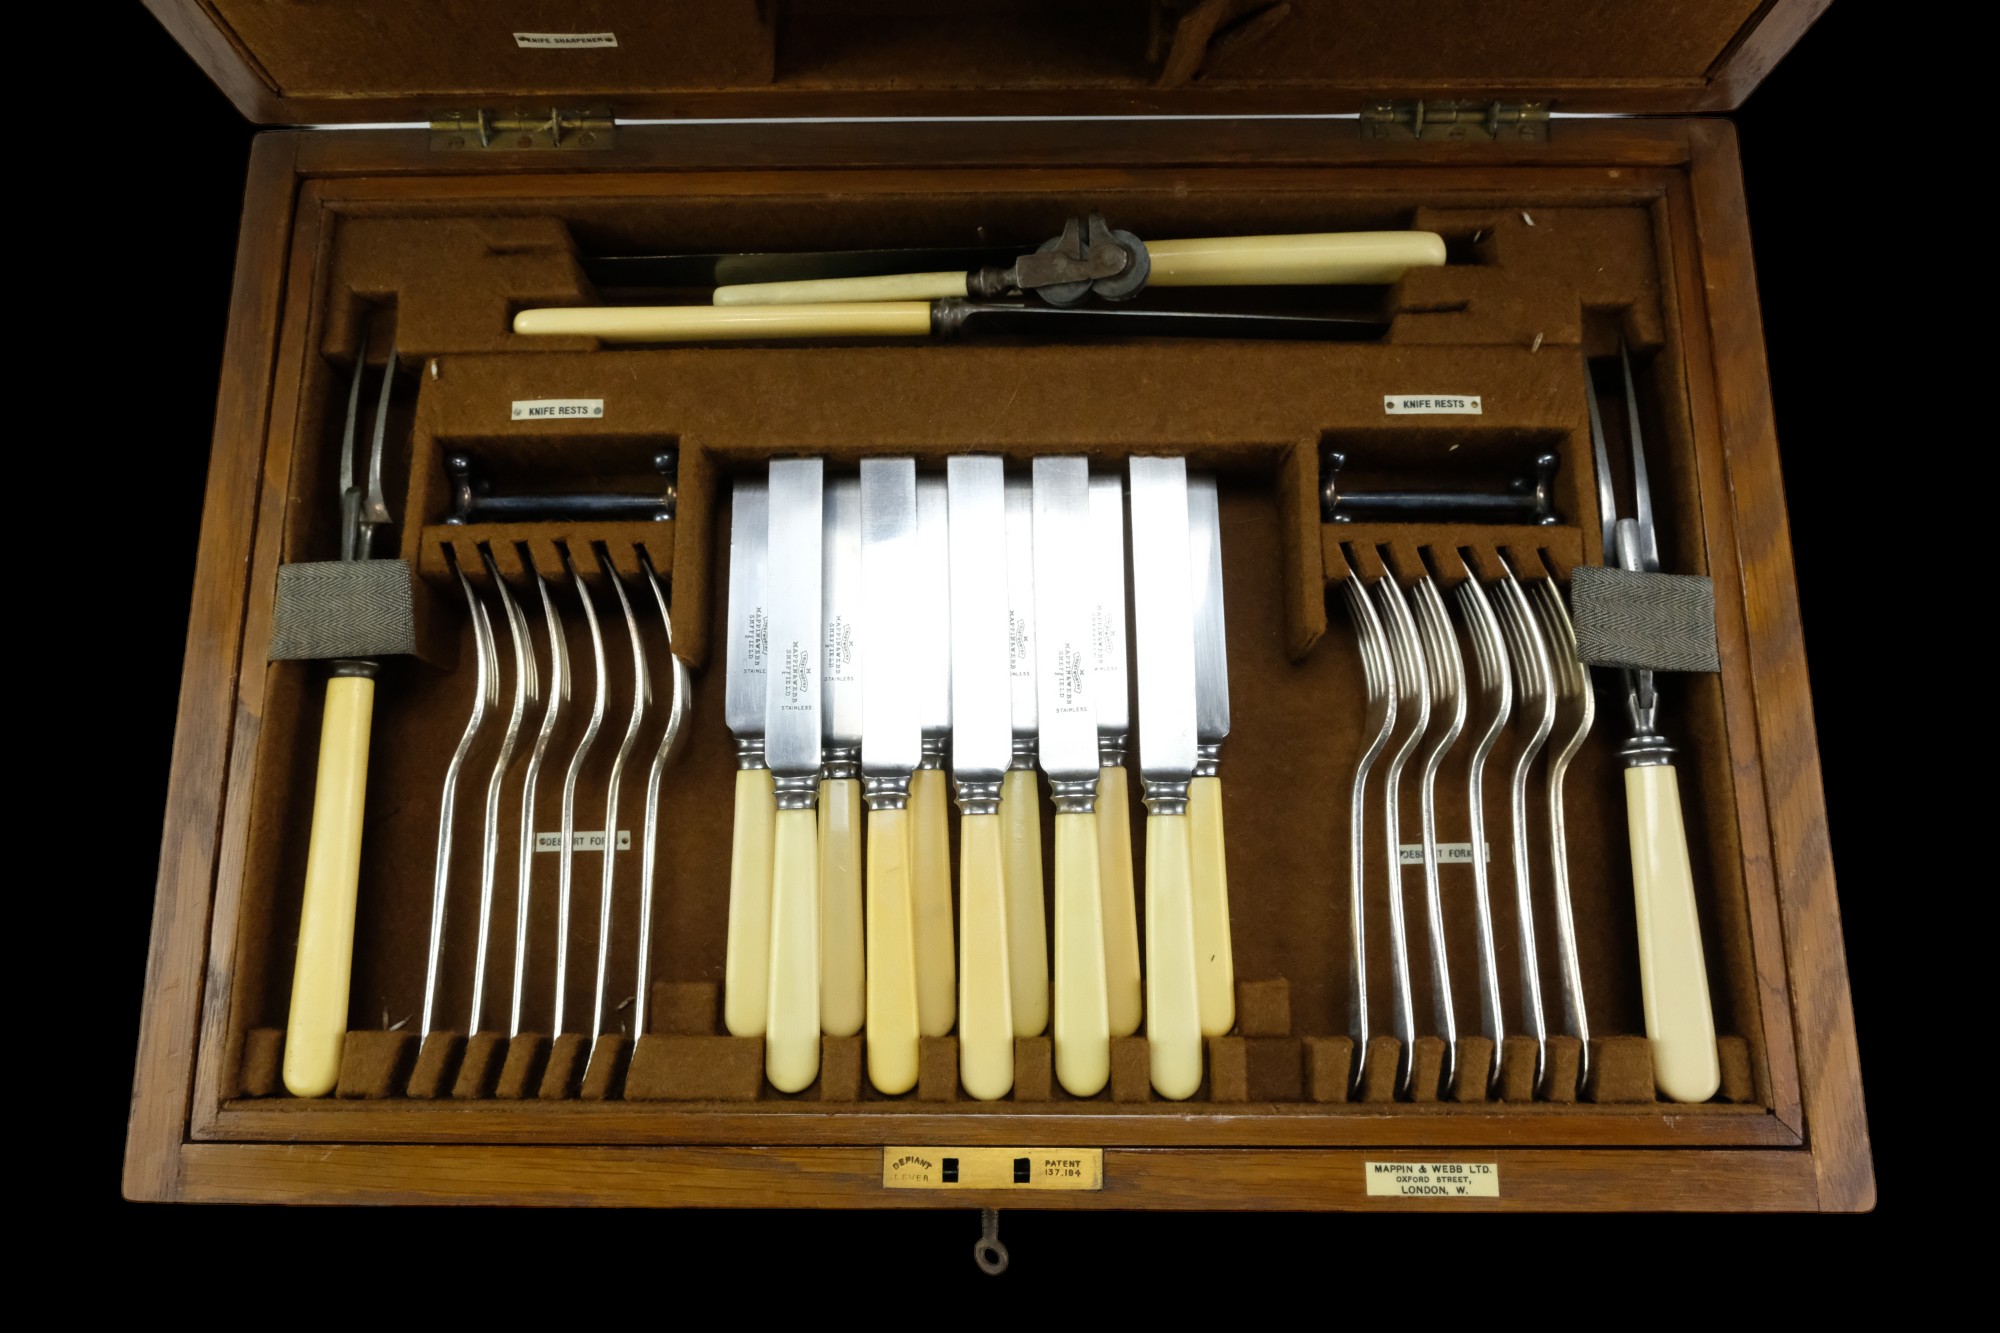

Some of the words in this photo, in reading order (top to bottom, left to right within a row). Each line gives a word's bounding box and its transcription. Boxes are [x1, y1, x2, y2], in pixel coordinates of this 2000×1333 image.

[1403, 400, 1431, 408] KNIFE
[1435, 400, 1465, 408] RESTS
[529, 407, 555, 415] KNIFE
[559, 406, 588, 414] RESTS
[546, 837, 584, 846] DESRT
[1449, 849, 1472, 858] FORK
[892, 1156, 932, 1170] DEFIANT
[1374, 1165, 1413, 1173] MAPPIN
[1419, 1165, 1427, 1173] &
[1432, 1165, 1463, 1173] WEBB
[1469, 1166, 1492, 1174] LTD.
[894, 1174, 929, 1182] LEVER
[1436, 1176, 1472, 1184] STREET,
[1401, 1186, 1449, 1195] LONDON,
[1456, 1186, 1468, 1195] W.
